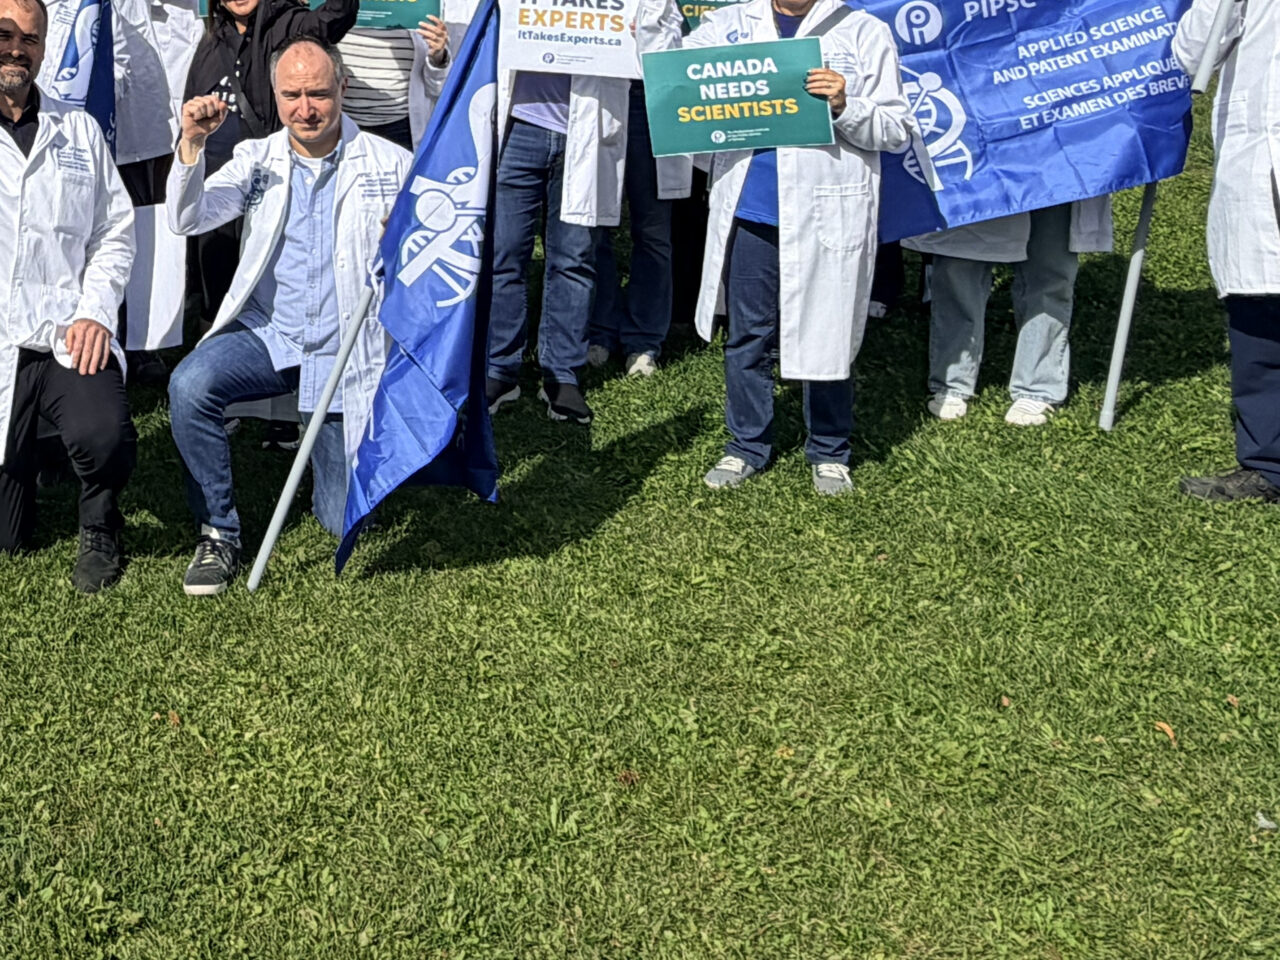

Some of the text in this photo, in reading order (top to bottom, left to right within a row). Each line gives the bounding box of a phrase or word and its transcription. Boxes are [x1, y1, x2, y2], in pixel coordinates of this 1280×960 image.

[518, 8, 625, 32] EXPERTS
[1017, 5, 1166, 59] APPLIED SCIENCE
[518, 30, 622, 46] ItTakesExperts.ca
[992, 21, 1177, 85] AND PATENT EXAMINAT
[686, 57, 778, 80] CANADA
[699, 80, 770, 100] NEEDS
[1023, 76, 1101, 109] SCIENCES
[677, 98, 799, 123] SCIENTISTS
[1019, 114, 1039, 130] ET
[1042, 98, 1113, 124] EXAMEN
[1113, 84, 1148, 103] DES
